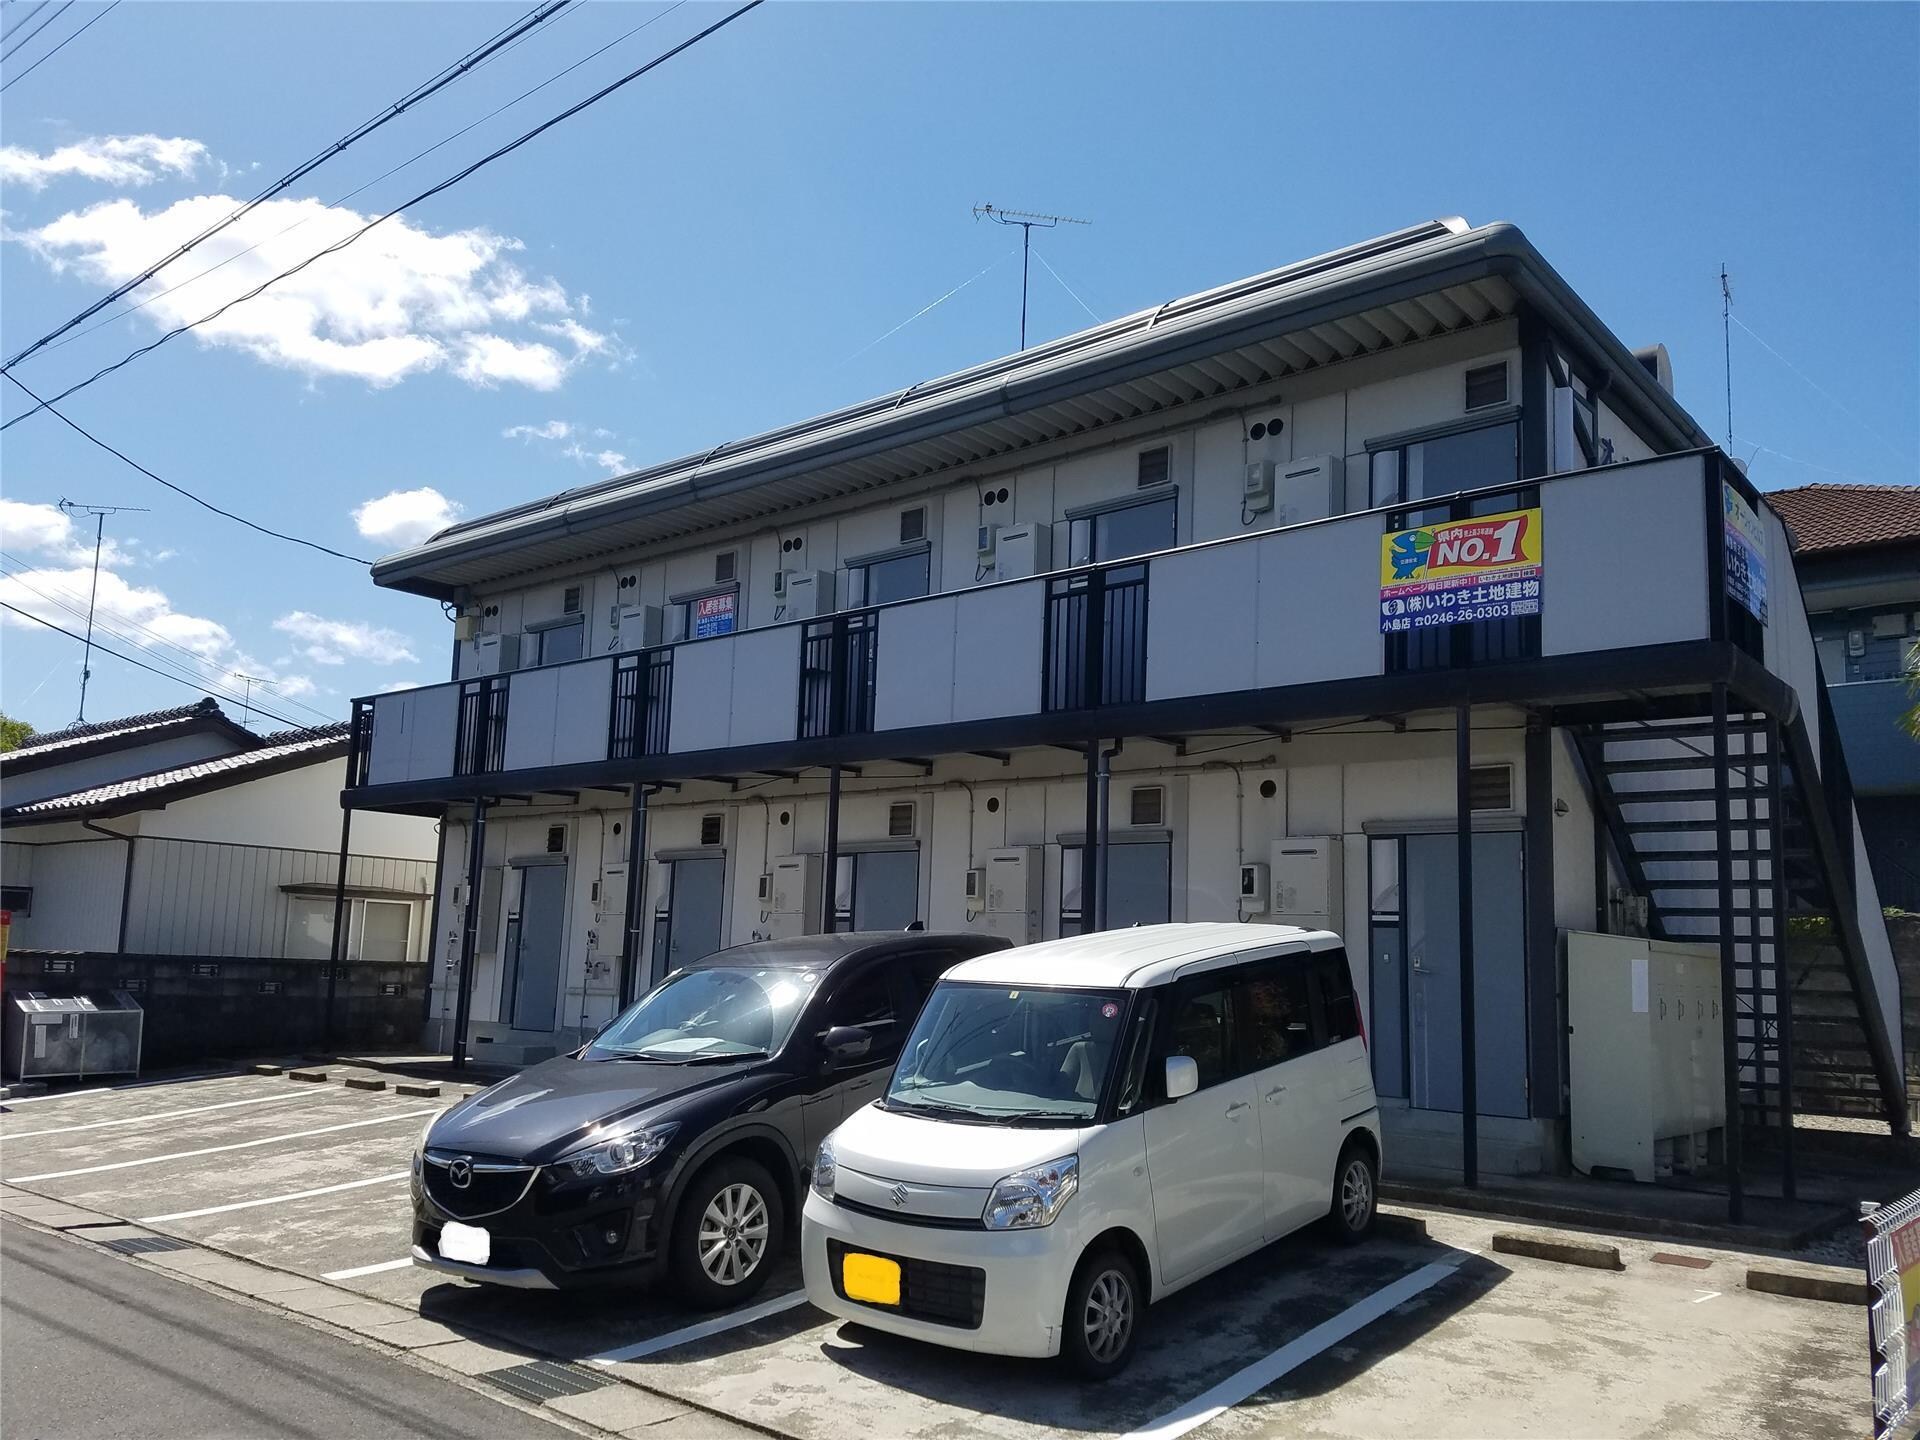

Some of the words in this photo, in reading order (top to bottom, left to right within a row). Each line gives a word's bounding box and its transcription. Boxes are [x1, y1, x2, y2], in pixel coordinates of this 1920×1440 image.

[1437, 528, 1463, 543] 県内
[1437, 520, 1520, 565] NO.1
[1406, 580, 1539, 612] (株)いわき土地建物
[698, 597, 733, 616] 入居者募集
[1382, 618, 1411, 632] 小島店
